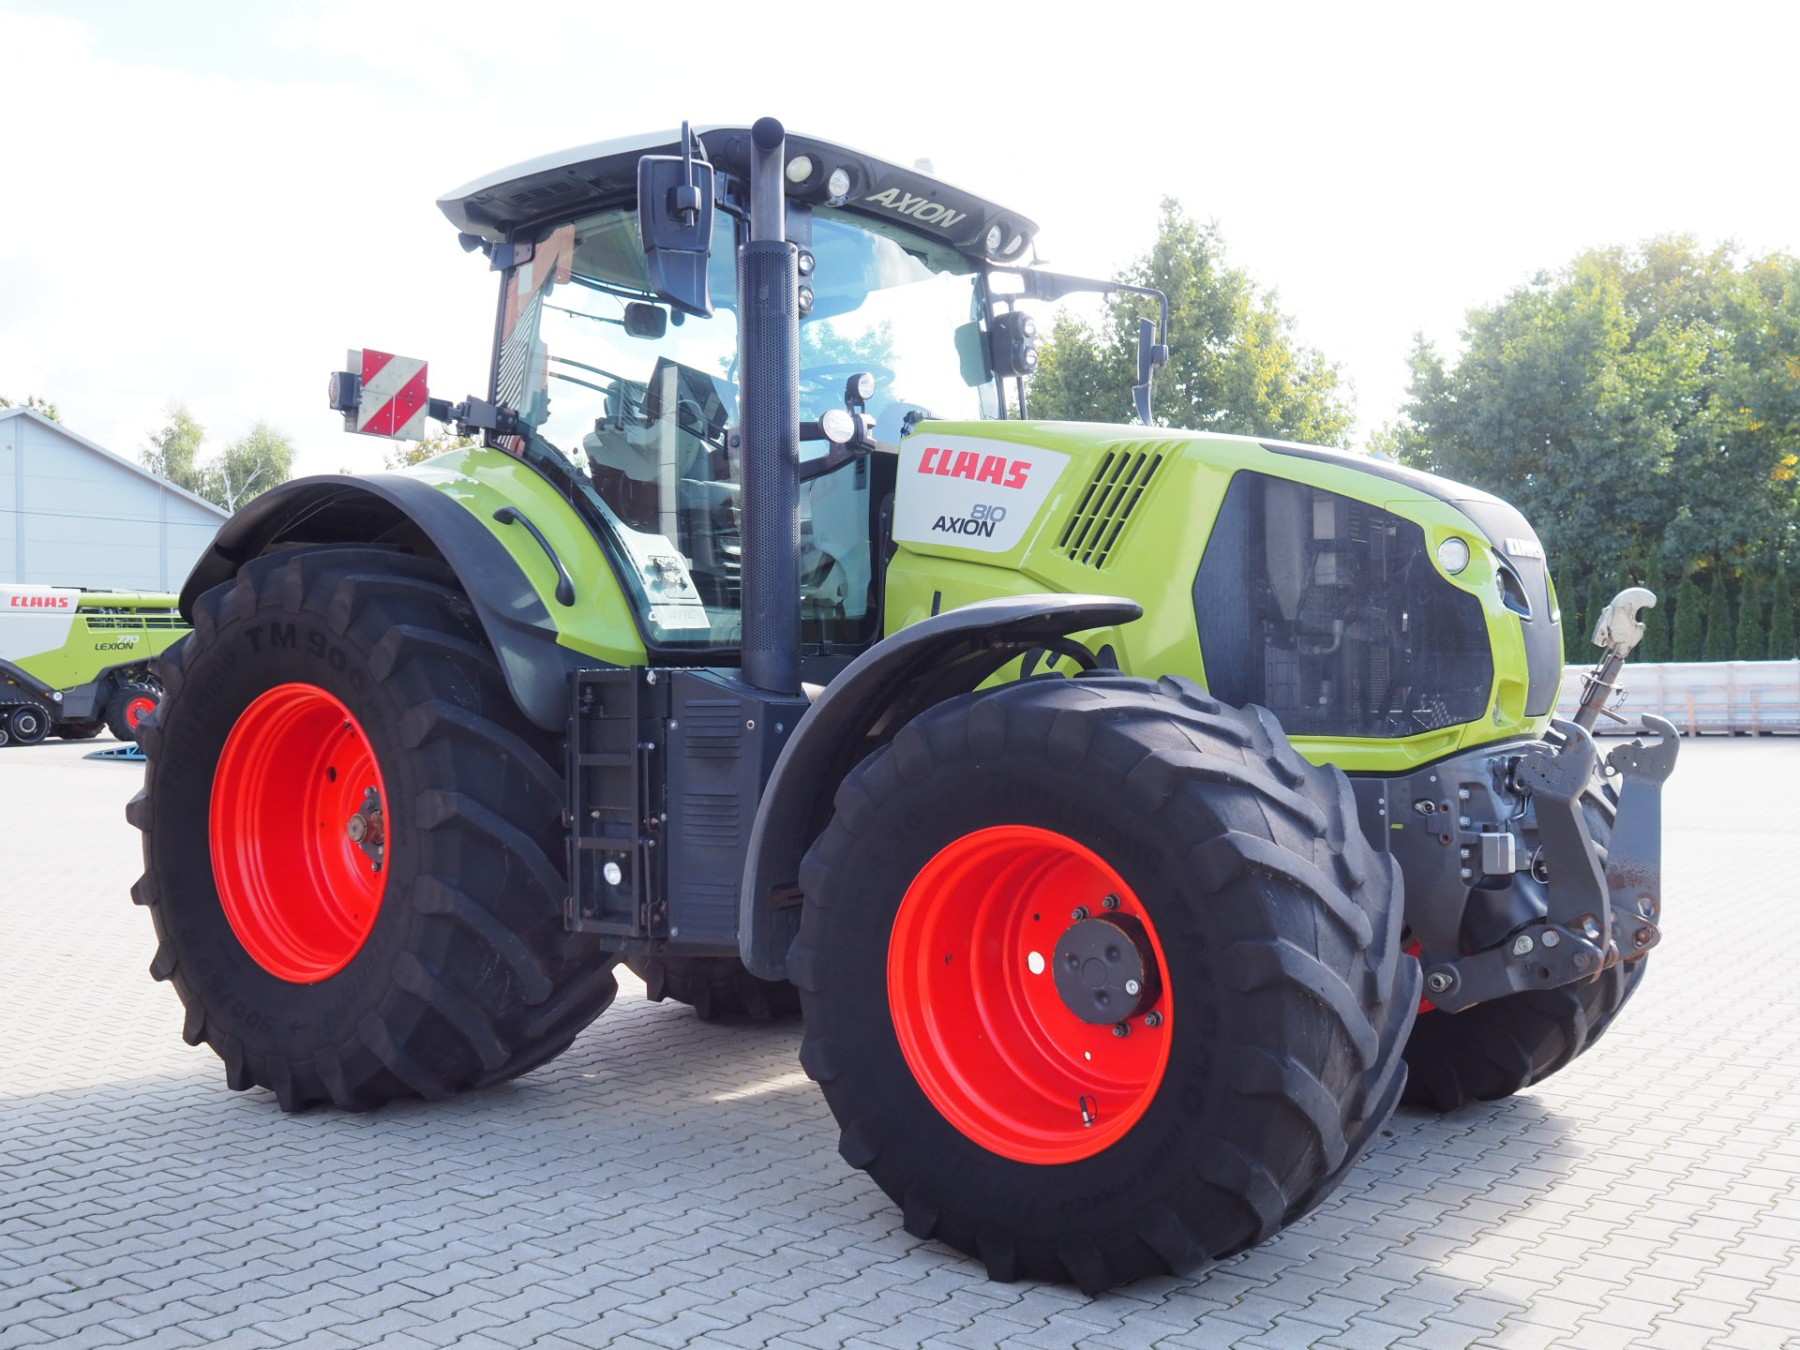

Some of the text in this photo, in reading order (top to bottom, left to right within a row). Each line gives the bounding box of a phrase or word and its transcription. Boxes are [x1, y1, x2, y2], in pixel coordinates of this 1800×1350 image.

[865, 188, 967, 228] AXION
[917, 447, 1032, 490] CLAAS
[970, 503, 1007, 523] 810
[931, 515, 996, 538] AXION
[10, 596, 69, 608] CLAAS
[94, 642, 134, 651] LEXION
[116, 634, 140, 644] 770
[244, 621, 297, 654] TM
